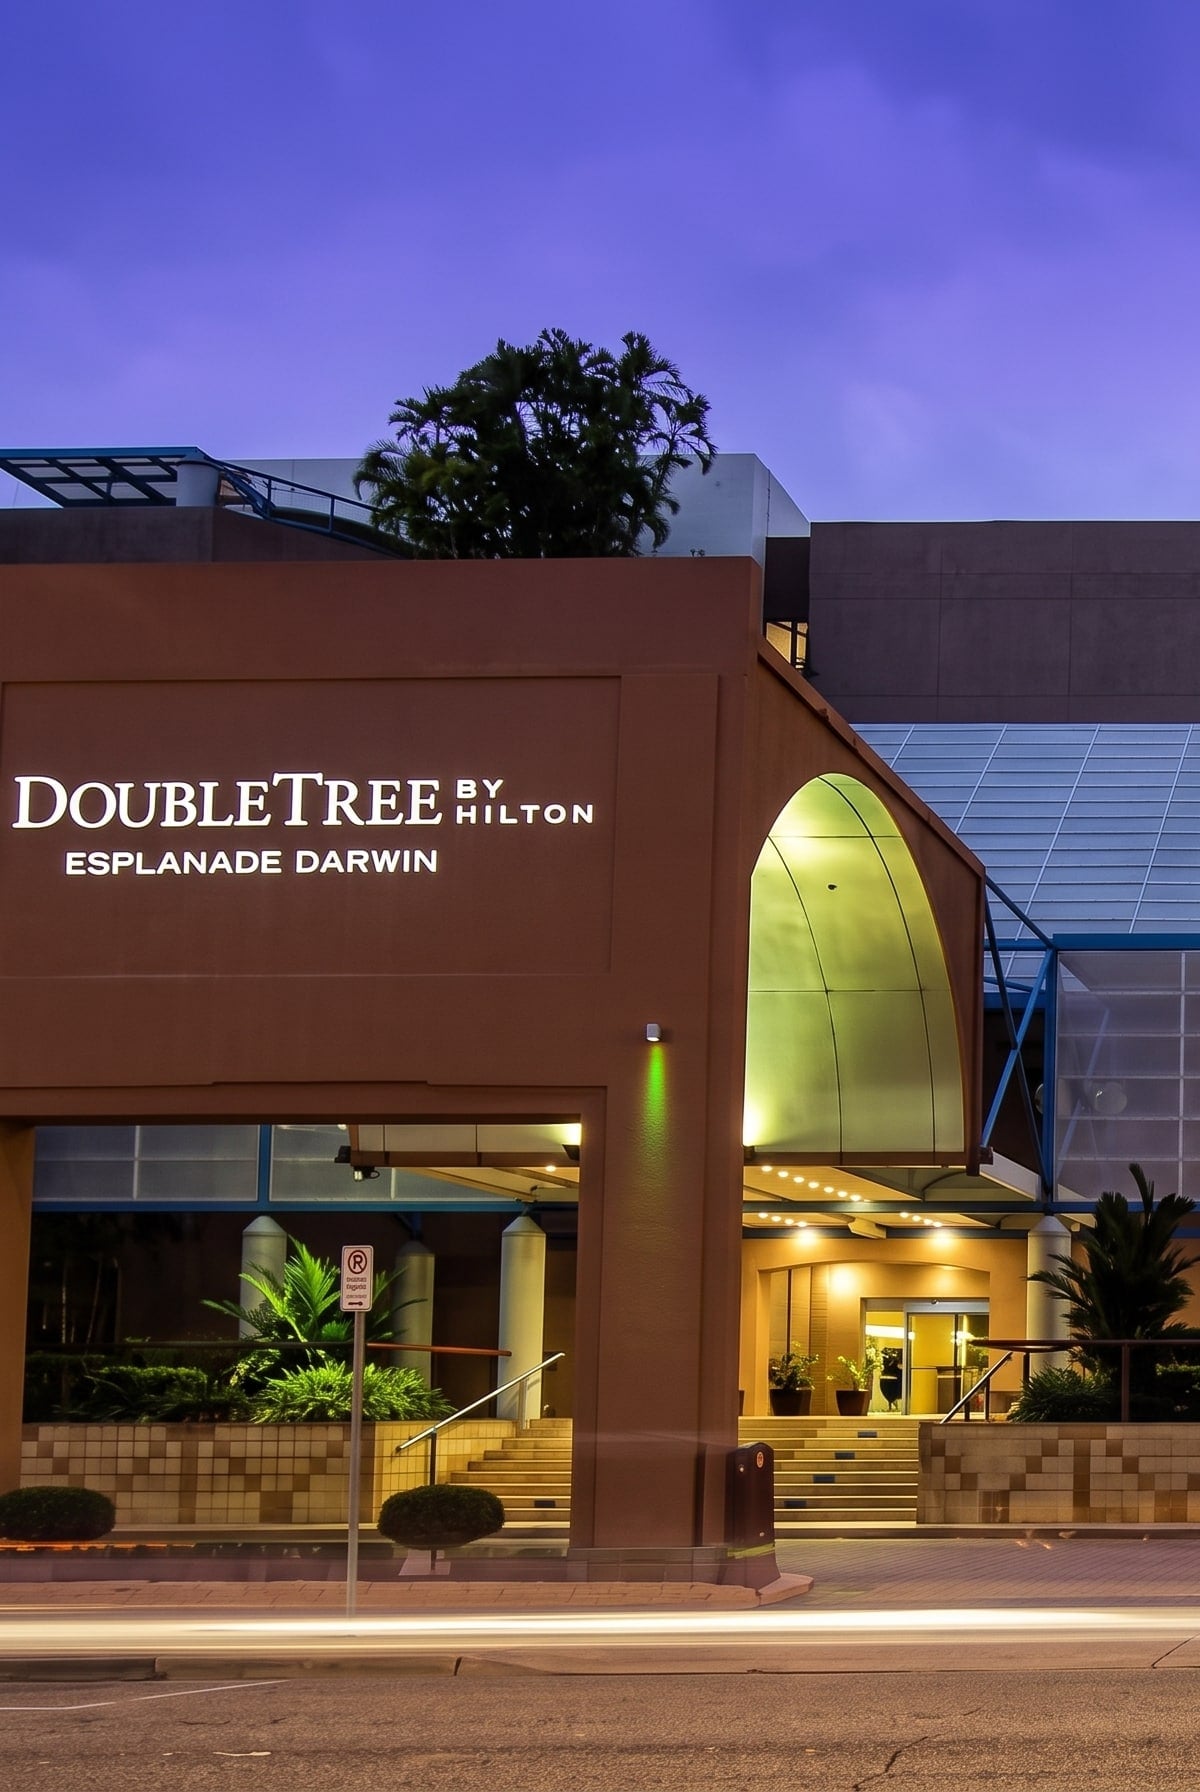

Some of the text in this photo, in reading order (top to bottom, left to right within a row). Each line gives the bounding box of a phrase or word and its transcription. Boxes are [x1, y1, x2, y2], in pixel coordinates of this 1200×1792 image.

[456, 779, 504, 799] BY
[456, 804, 594, 825] HILTON
[65, 849, 438, 876] ESPLANADE DARWIN
